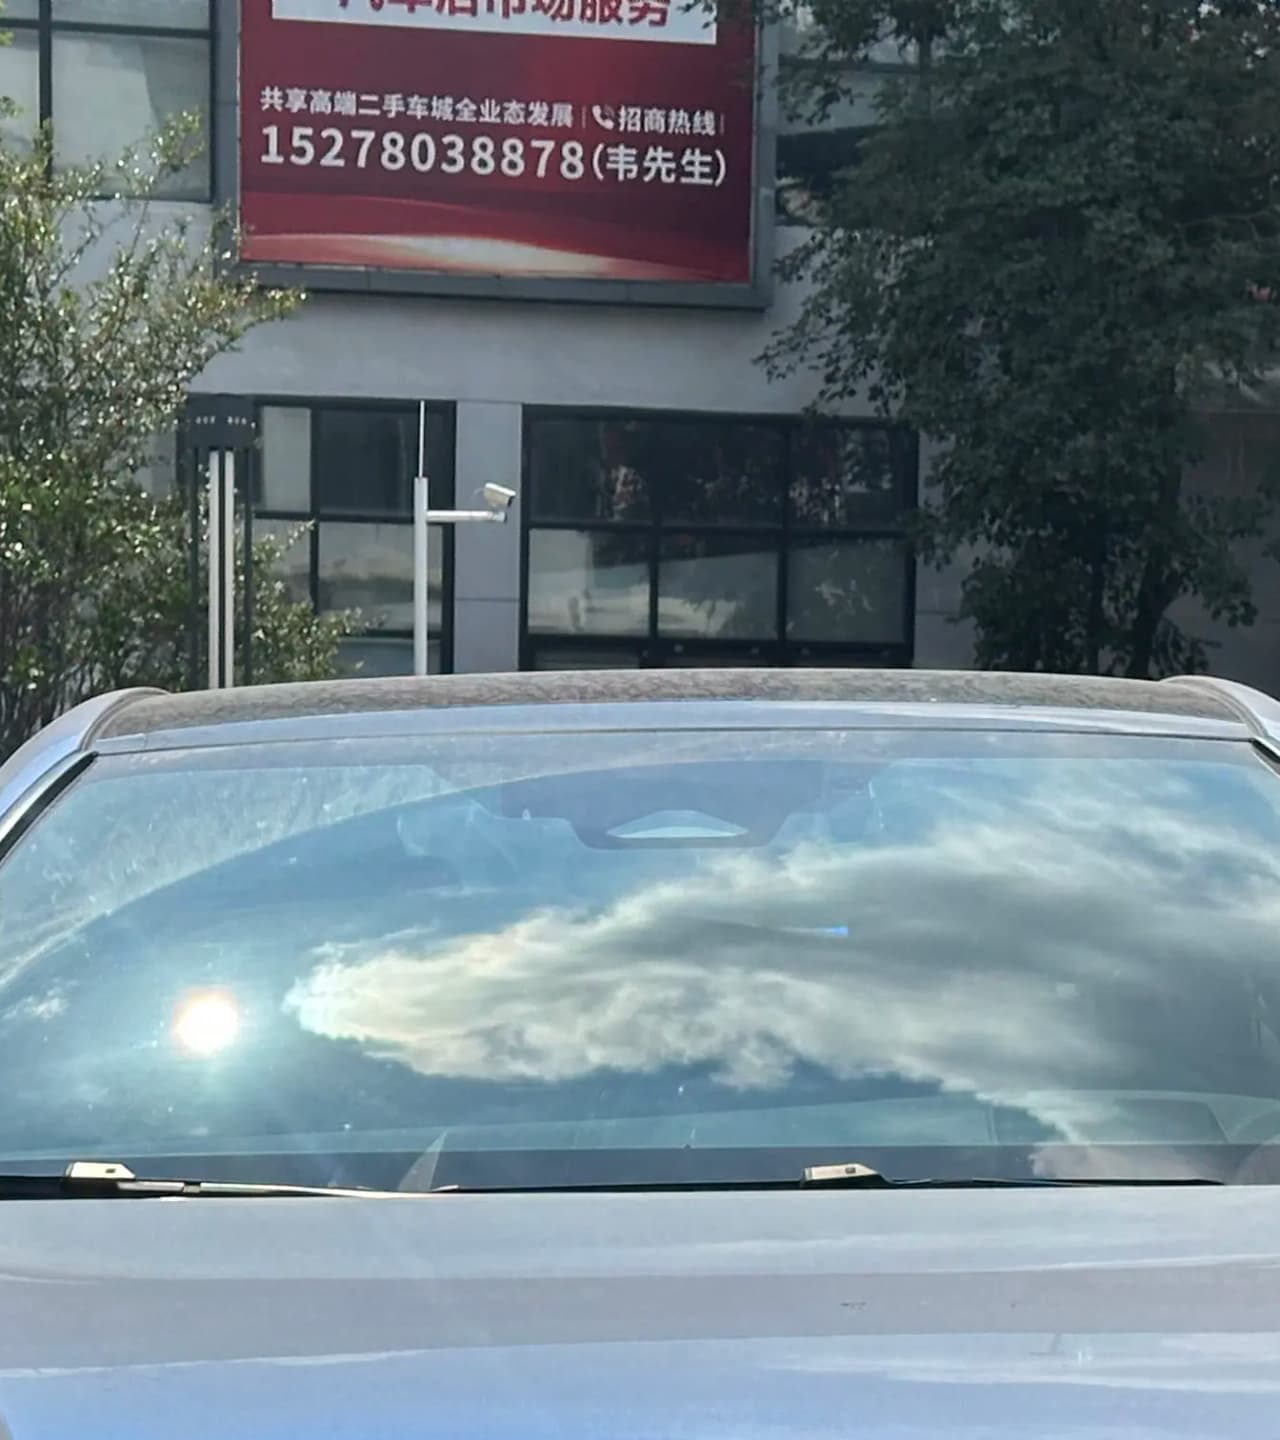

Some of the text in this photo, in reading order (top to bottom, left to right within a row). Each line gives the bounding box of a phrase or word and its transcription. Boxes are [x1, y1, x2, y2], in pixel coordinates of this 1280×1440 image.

[618, 105, 716, 137] 招商热线
[260, 125, 727, 188] 15278038878(韦先生)
